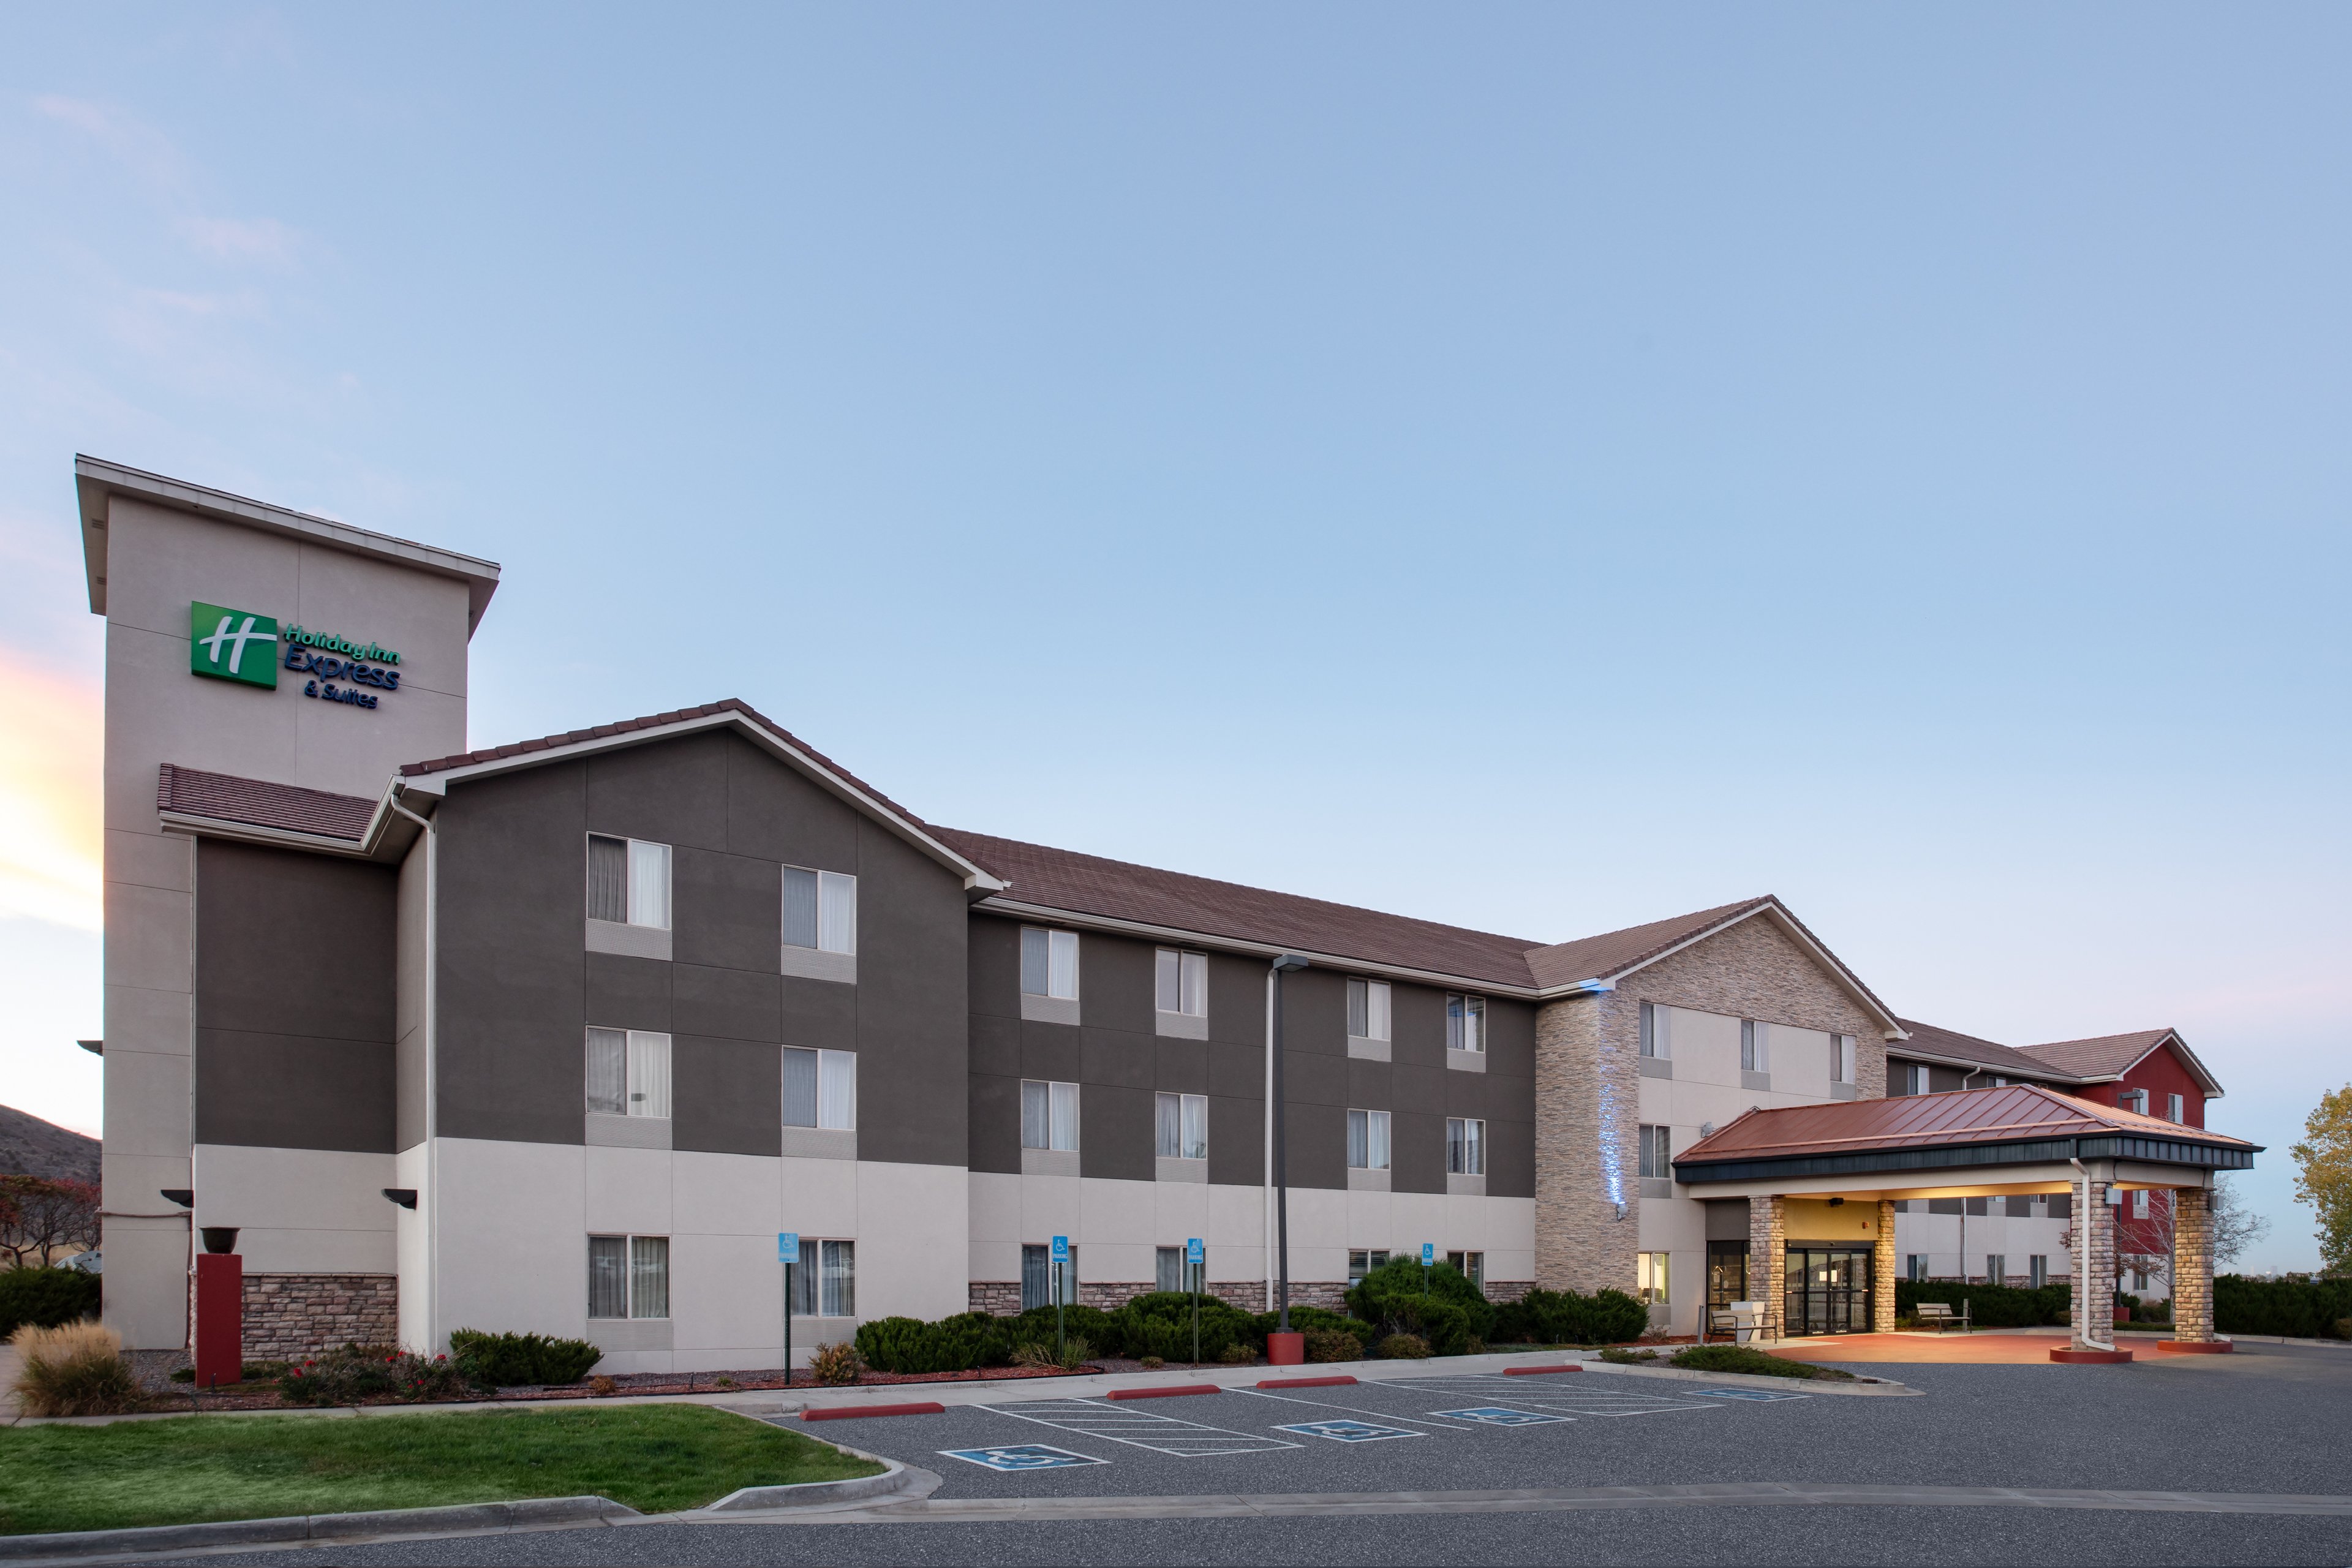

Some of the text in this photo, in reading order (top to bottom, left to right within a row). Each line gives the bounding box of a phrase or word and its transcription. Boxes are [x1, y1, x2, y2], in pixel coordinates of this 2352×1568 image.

[284, 623, 401, 666] Holiday Inn
[284, 644, 401, 690] Express
[304, 680, 378, 709] & Suites
